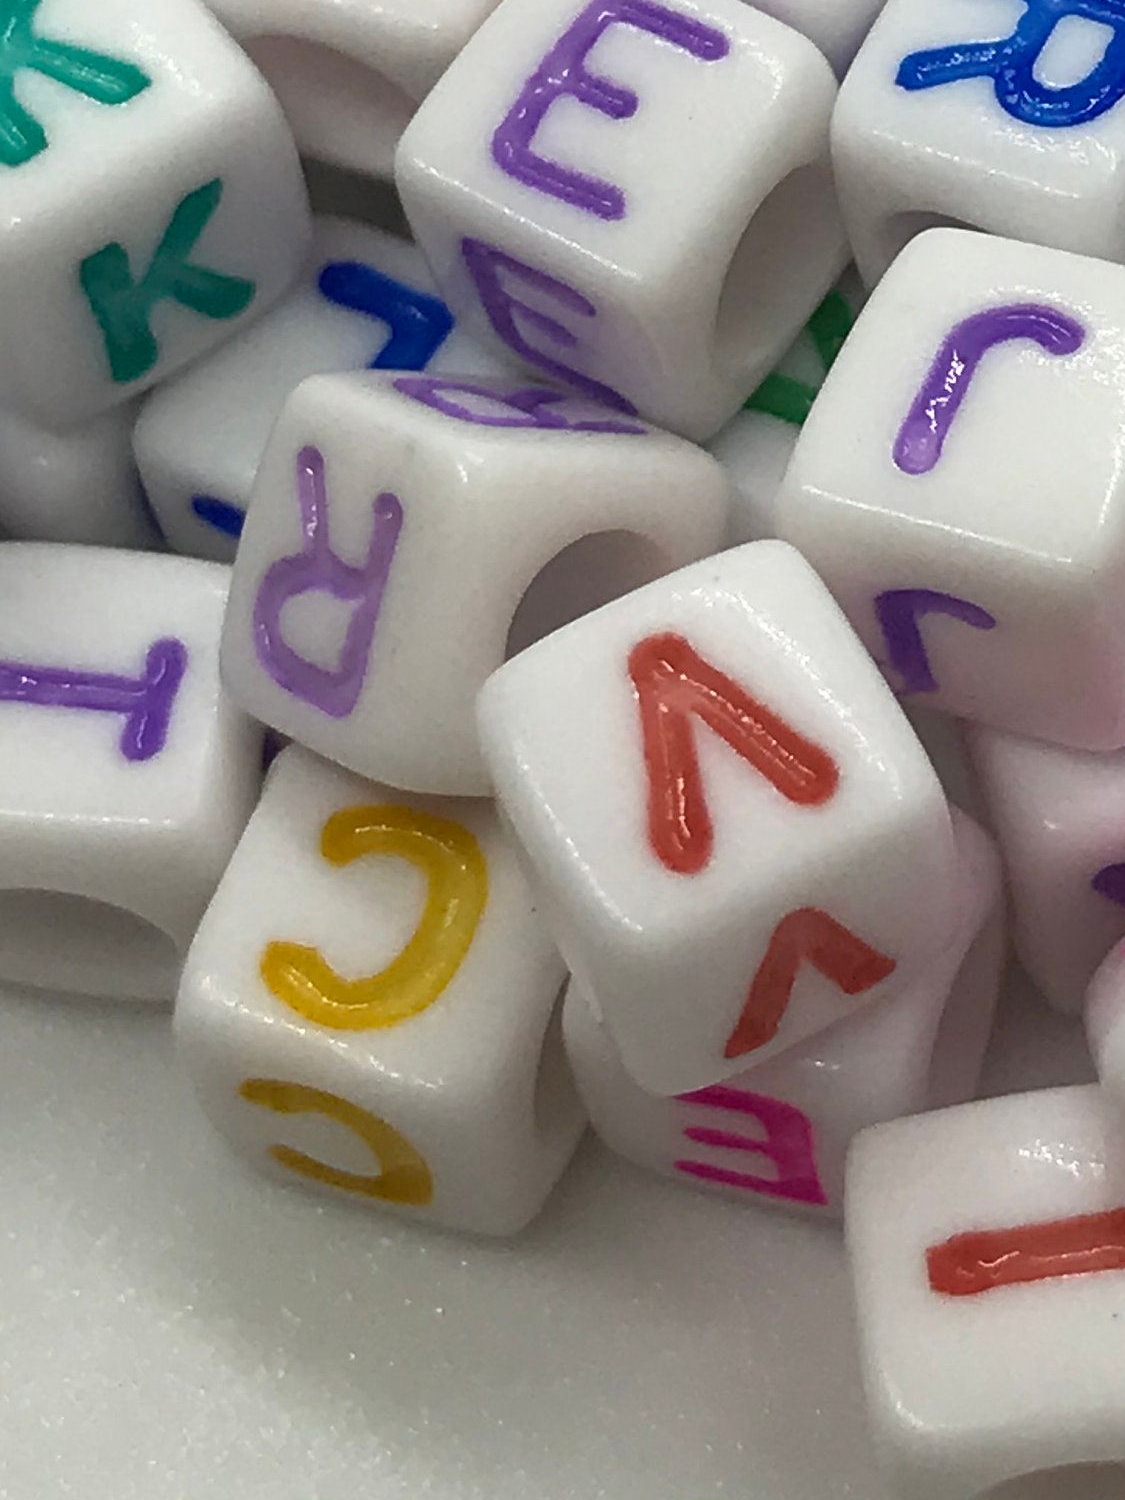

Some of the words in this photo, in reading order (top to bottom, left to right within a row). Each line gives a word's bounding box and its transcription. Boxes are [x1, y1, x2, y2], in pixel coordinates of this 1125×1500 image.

[80, 178, 256, 384] K
[460, 238, 638, 417] E
[893, 304, 1086, 475] J
[254, 445, 403, 719] R
[0, 637, 187, 762] T
[256, 803, 489, 1032] C
[237, 1078, 434, 1206] C
[674, 1085, 829, 1206] E
